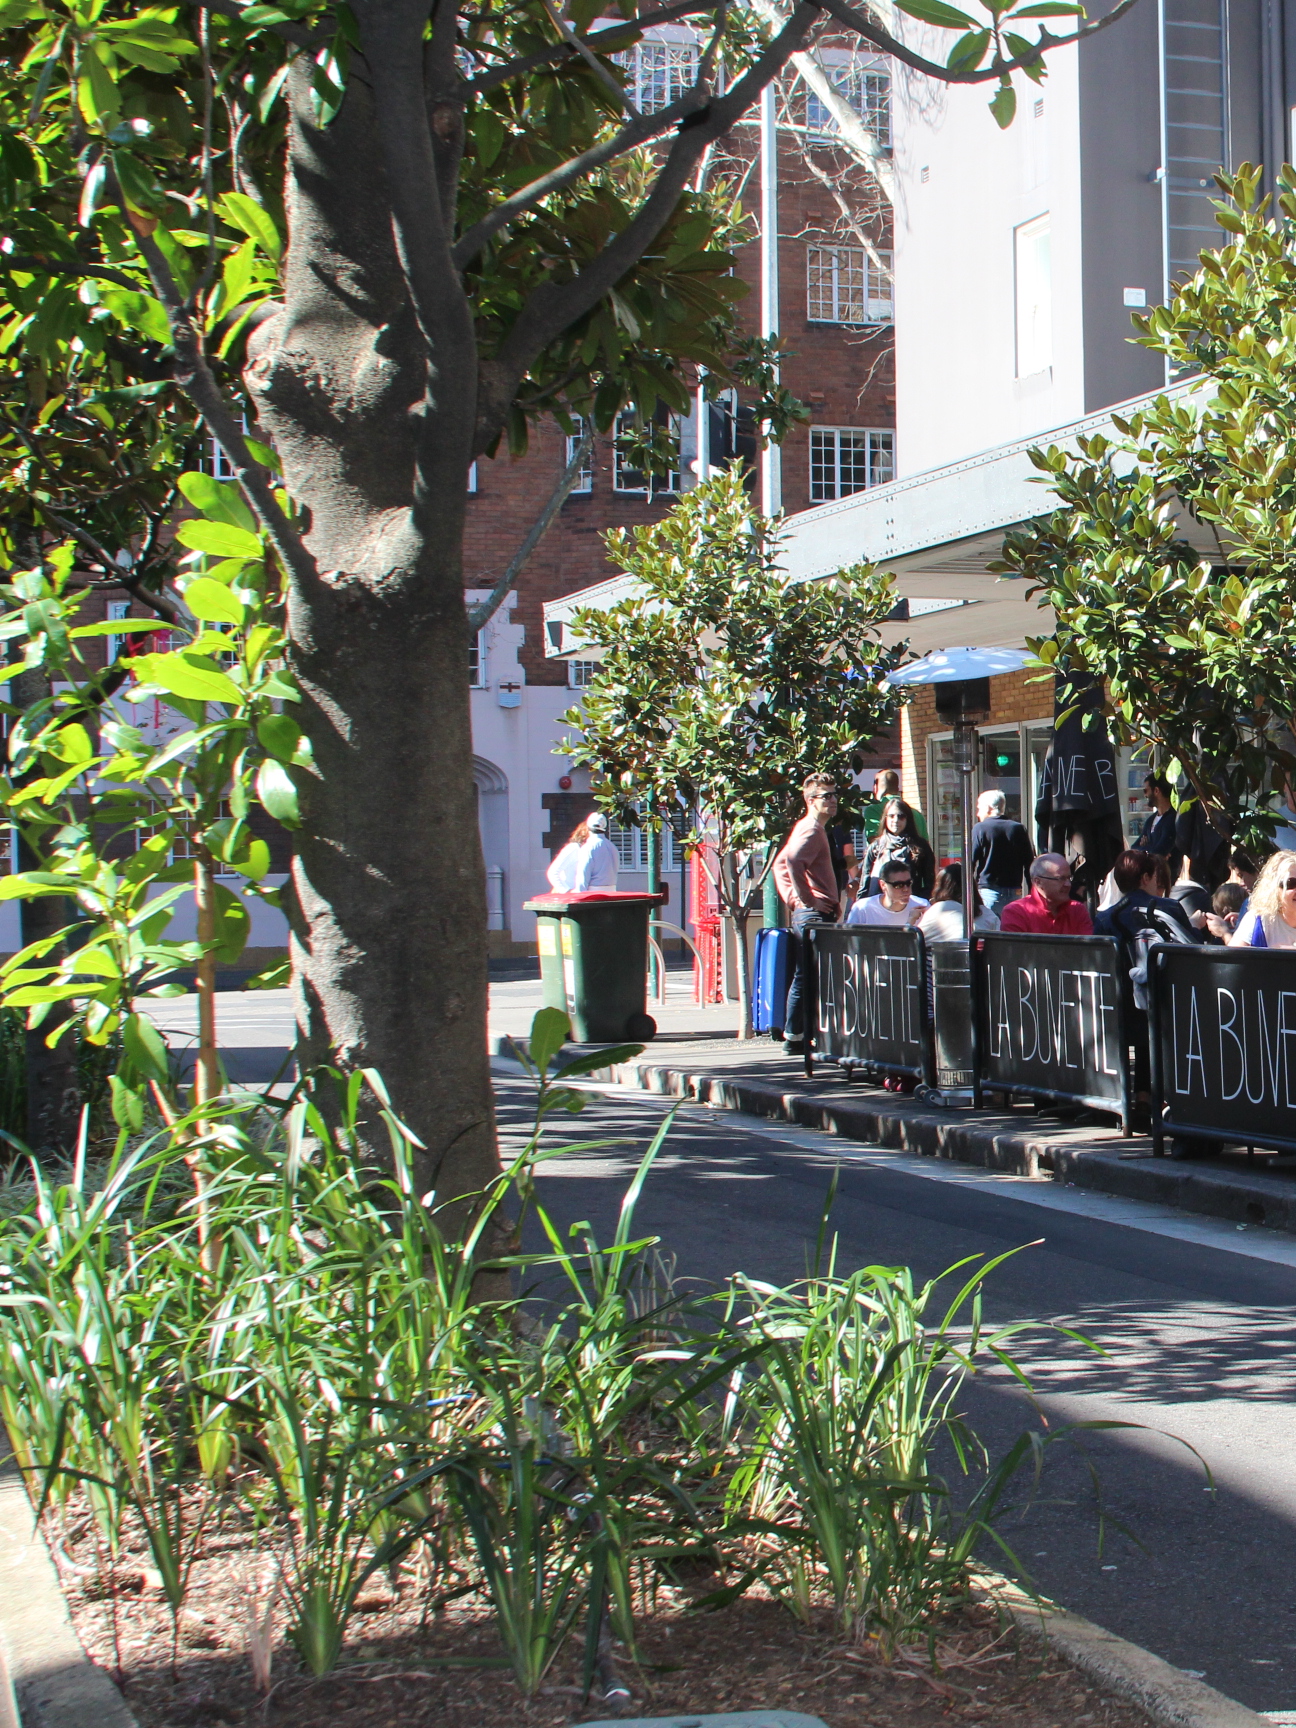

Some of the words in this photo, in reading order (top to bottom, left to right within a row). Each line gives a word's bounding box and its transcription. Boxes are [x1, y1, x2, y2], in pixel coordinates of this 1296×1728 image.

[818, 951, 837, 1033] LA
[843, 954, 919, 1044] BUVETTE
[987, 964, 1012, 1058] LA
[1019, 967, 1117, 1075] BUVETTE
[1172, 984, 1207, 1098] LA
